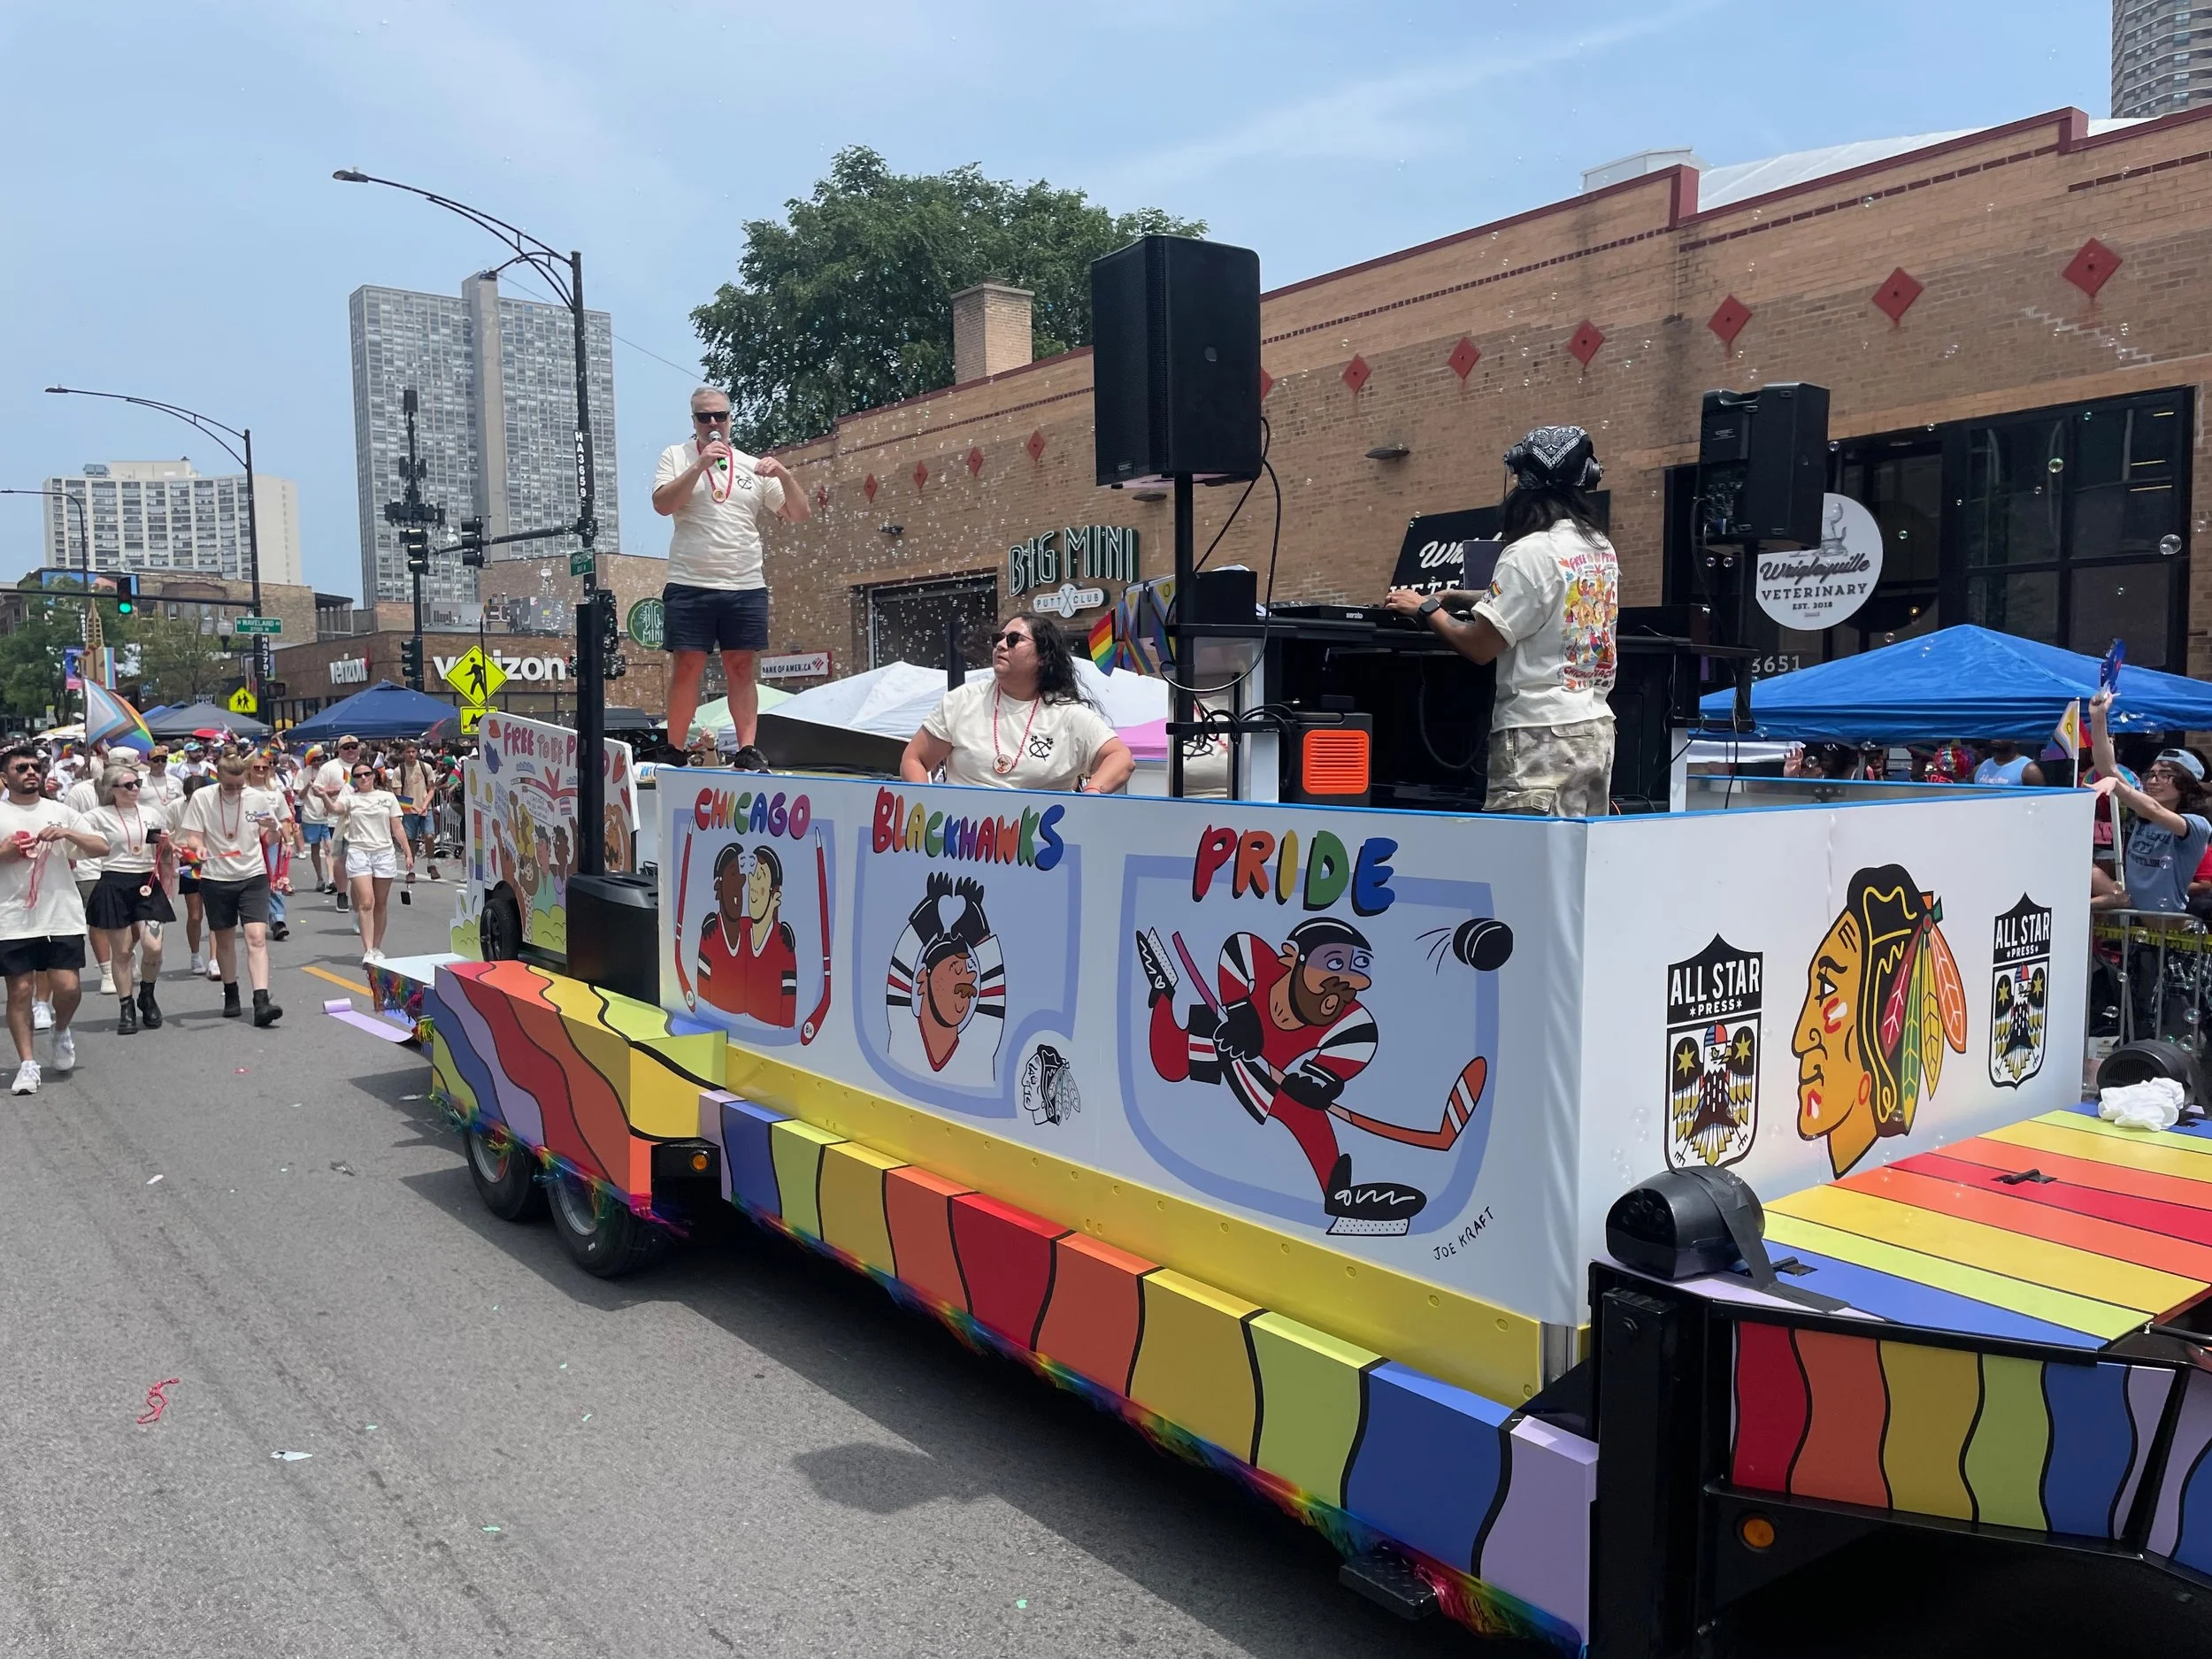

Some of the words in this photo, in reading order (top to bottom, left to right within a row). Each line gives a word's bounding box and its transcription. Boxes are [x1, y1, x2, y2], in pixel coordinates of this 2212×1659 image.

[575, 431, 587, 497] HA3659
[1009, 531, 1057, 597] BIG
[1064, 525, 1137, 584] MINI
[1759, 553, 1870, 585] Wrigleyville
[1037, 597, 1061, 608] PUTT
[1073, 594, 1099, 603] CLUB
[1762, 583, 1868, 601] VETERINARY
[642, 629, 664, 642] MINI
[329, 652, 368, 685] verizon
[432, 649, 566, 681] vizon
[1752, 655, 1801, 673] 3651
[503, 722, 534, 757] FREE
[537, 733, 549, 758] TO
[550, 736, 564, 765] BE
[695, 787, 811, 840] CHICAGO
[872, 786, 1065, 871] BLACKHAWKS
[1192, 824, 1399, 917] PRIDE
[1995, 917, 2018, 949] ALL
[2020, 911, 2050, 945] STAR
[2011, 944, 2034, 957] PRESS
[1670, 965, 1708, 1006] ALL
[1712, 957, 1760, 999] STAR
[1698, 998, 1735, 1016] PRESS
[1433, 1242, 1457, 1260] JOE
[1457, 1205, 1494, 1248] KRAFT
